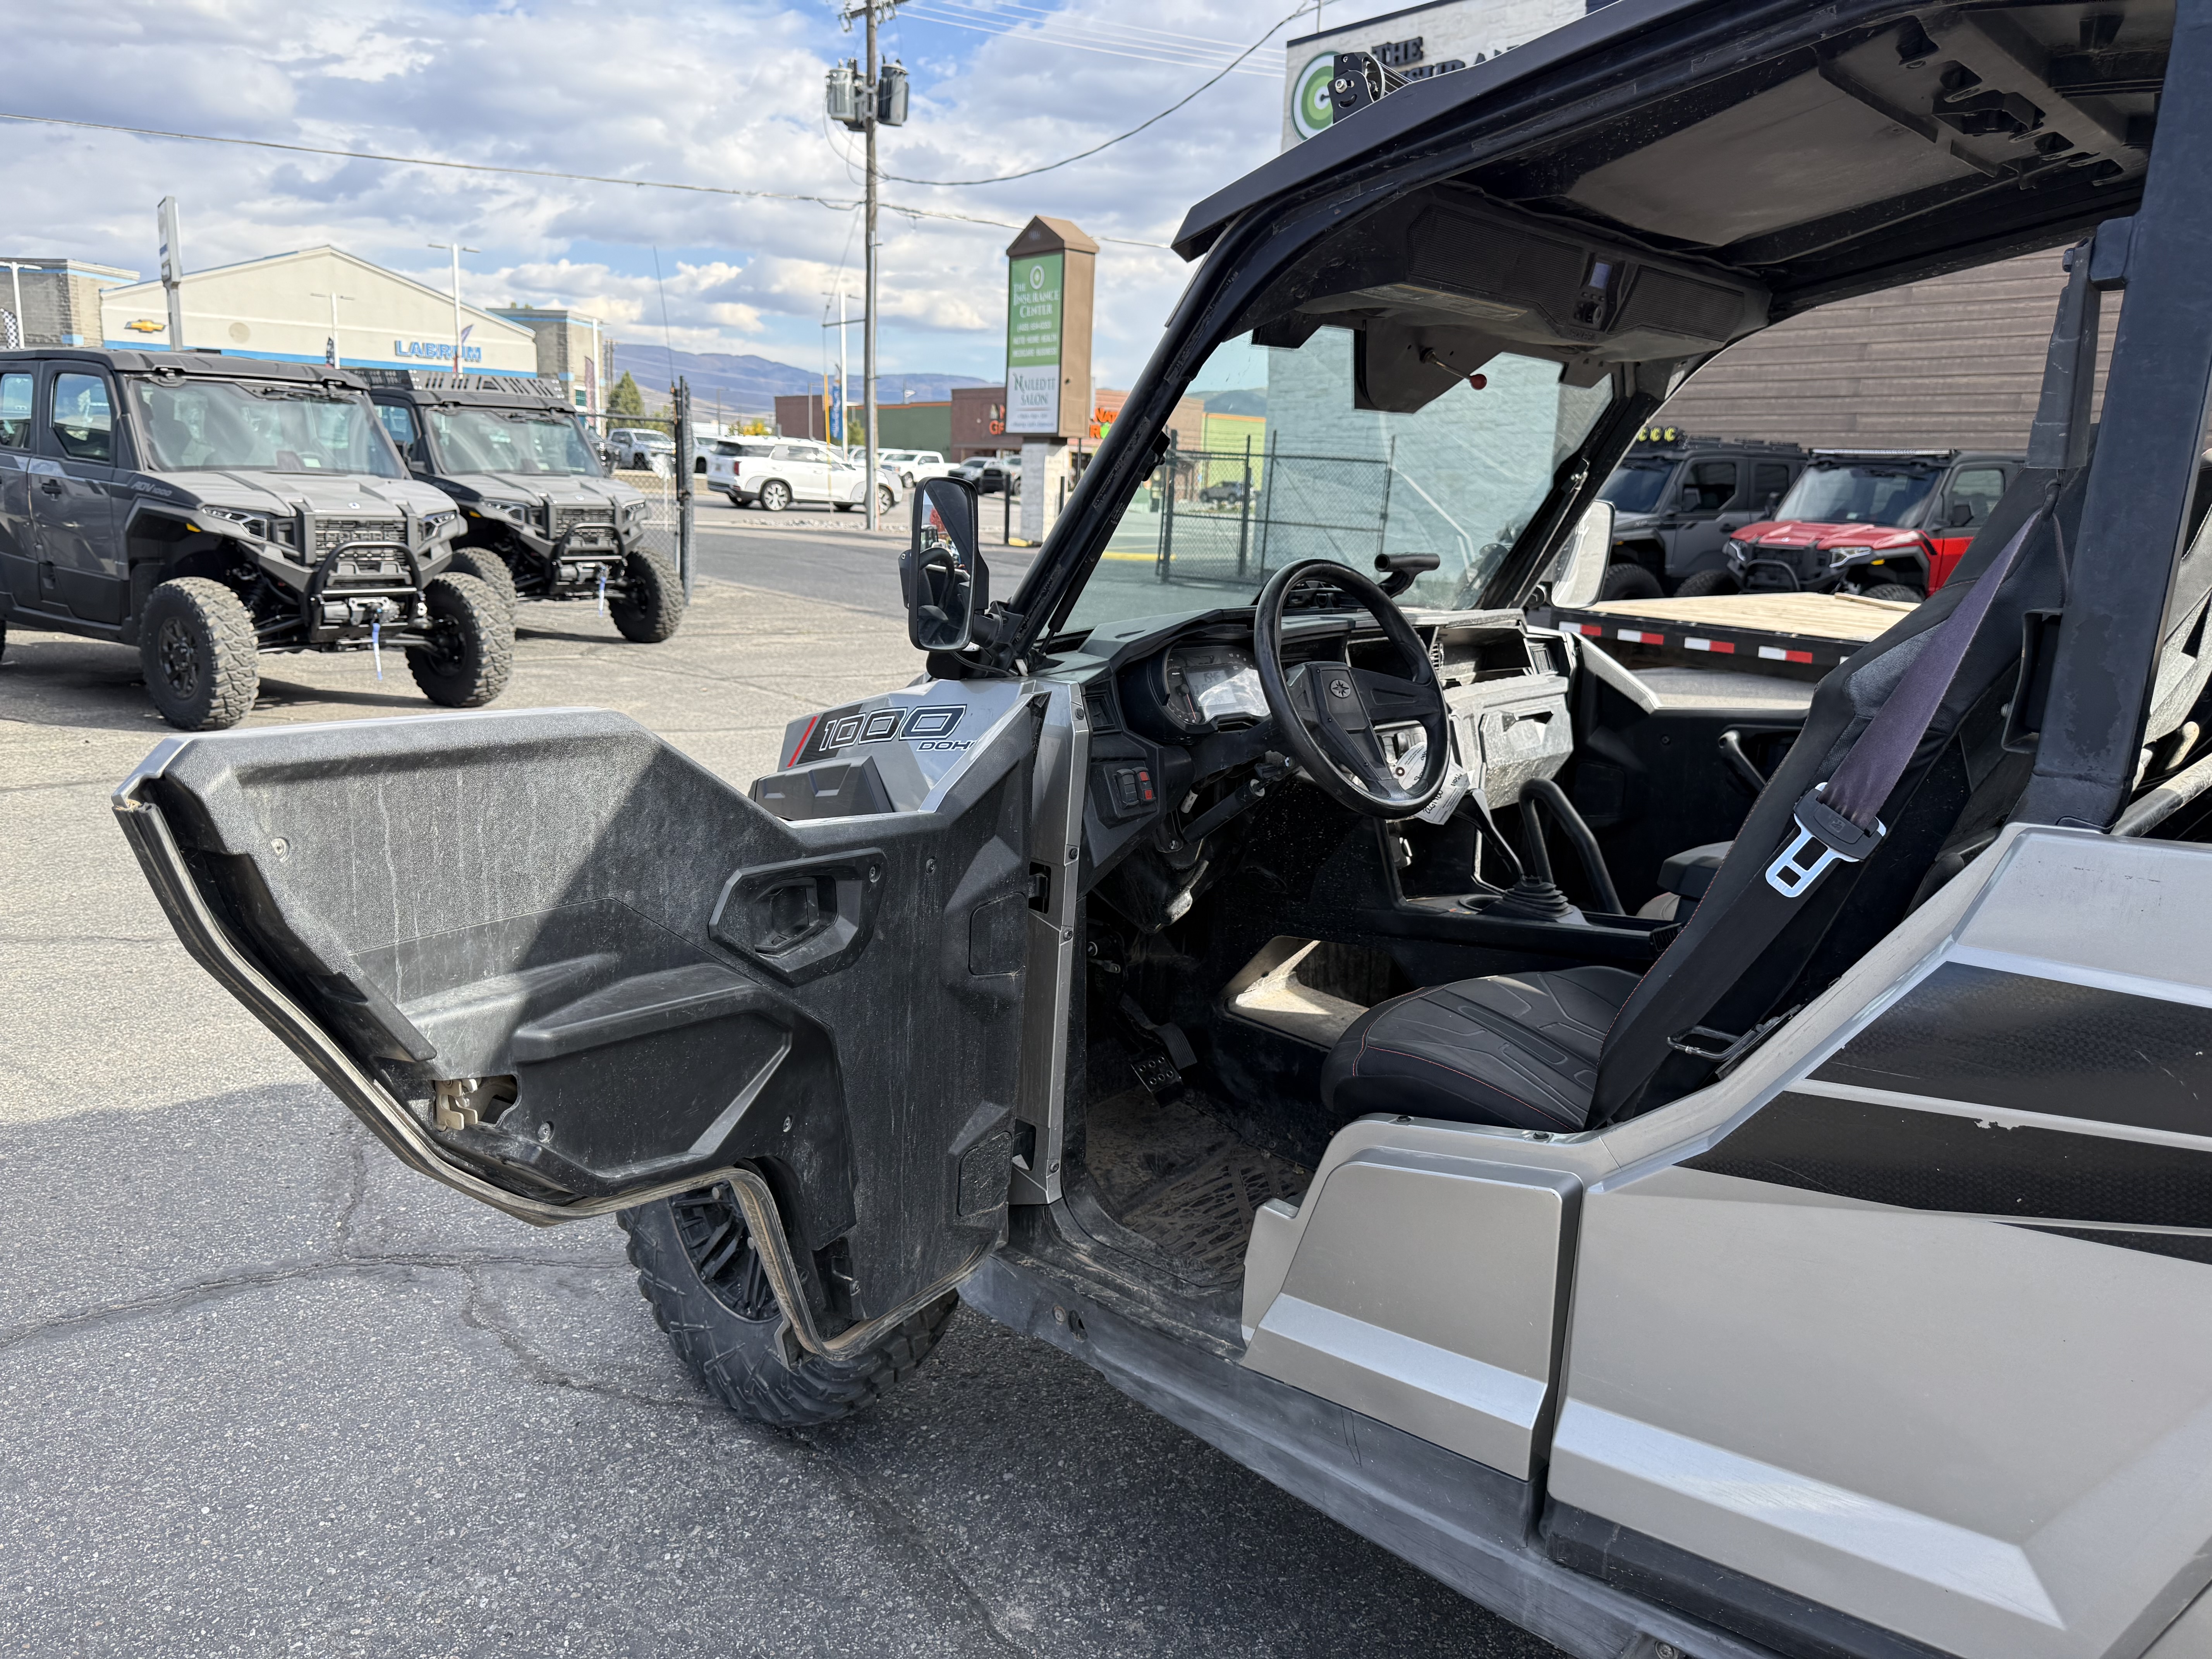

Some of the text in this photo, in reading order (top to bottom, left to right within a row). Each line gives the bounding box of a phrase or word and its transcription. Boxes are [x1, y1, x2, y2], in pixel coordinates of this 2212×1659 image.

[1372, 36, 1423, 67] THE
[1013, 289, 1060, 306] INSURANCE
[1019, 303, 1053, 318] CENTER
[394, 340, 482, 362] LABRUM
[1021, 392, 1049, 405] SALON
[1093, 407, 1119, 423] NAT
[131, 481, 155, 492] ADV
[325, 530, 399, 542] POLARIS
[819, 704, 967, 751] 1000
[916, 740, 976, 752] DOH
